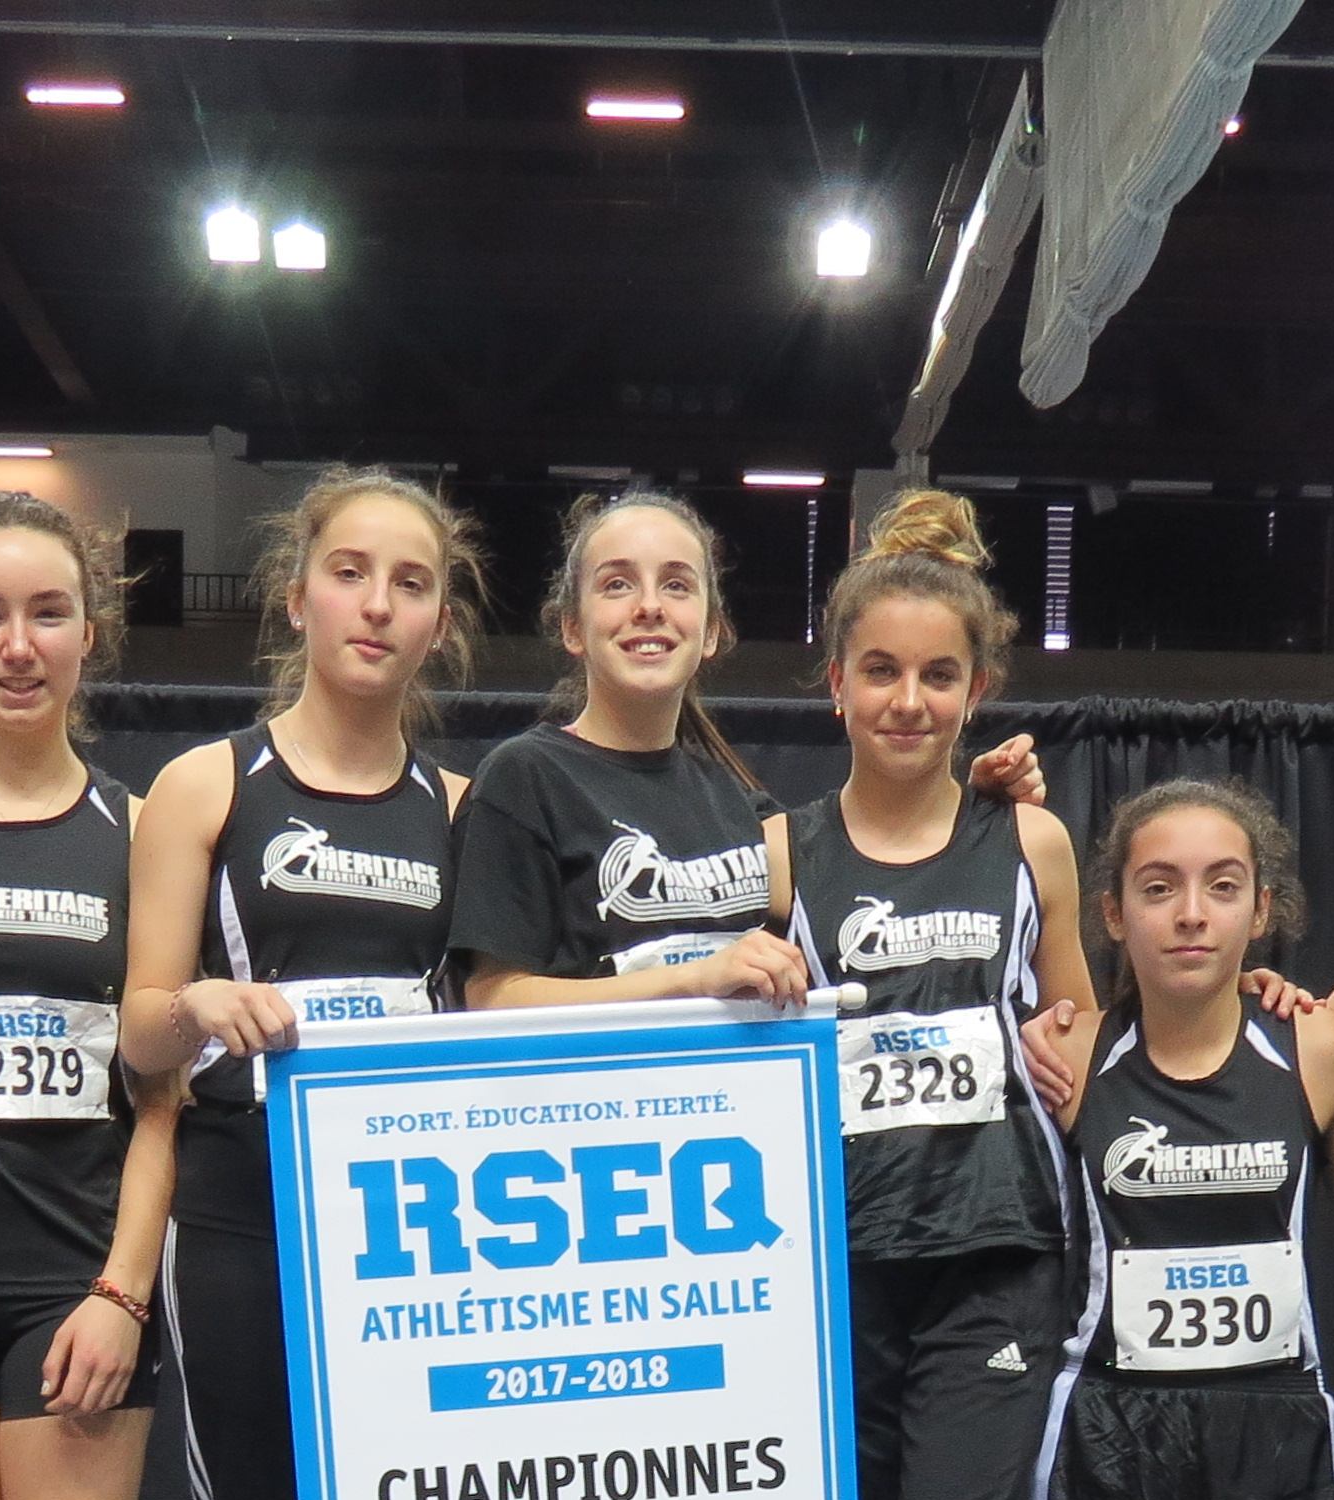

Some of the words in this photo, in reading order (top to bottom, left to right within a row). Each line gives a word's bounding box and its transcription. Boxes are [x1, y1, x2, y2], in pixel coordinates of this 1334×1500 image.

[317, 847, 441, 889] HERITAGE
[886, 911, 1001, 944] HERITAGE
[304, 996, 386, 1021] RSEQ
[871, 1026, 950, 1053] RSEQ
[860, 1054, 977, 1111] 2328
[365, 1109, 456, 1136] SPORT.
[464, 1101, 631, 1130] ÉDUCATION.
[635, 1090, 736, 1119] FIERTÉ.
[1155, 1140, 1288, 1171] HERITAGE
[348, 1136, 784, 1281] RSEQ
[1165, 1264, 1249, 1290] RSEQ
[361, 1289, 592, 1342] ATHLÉTISME
[604, 1286, 648, 1322] EN
[660, 1278, 771, 1319] SALLE
[1148, 1294, 1271, 1348] 2330
[485, 1357, 671, 1401] 2017-2018
